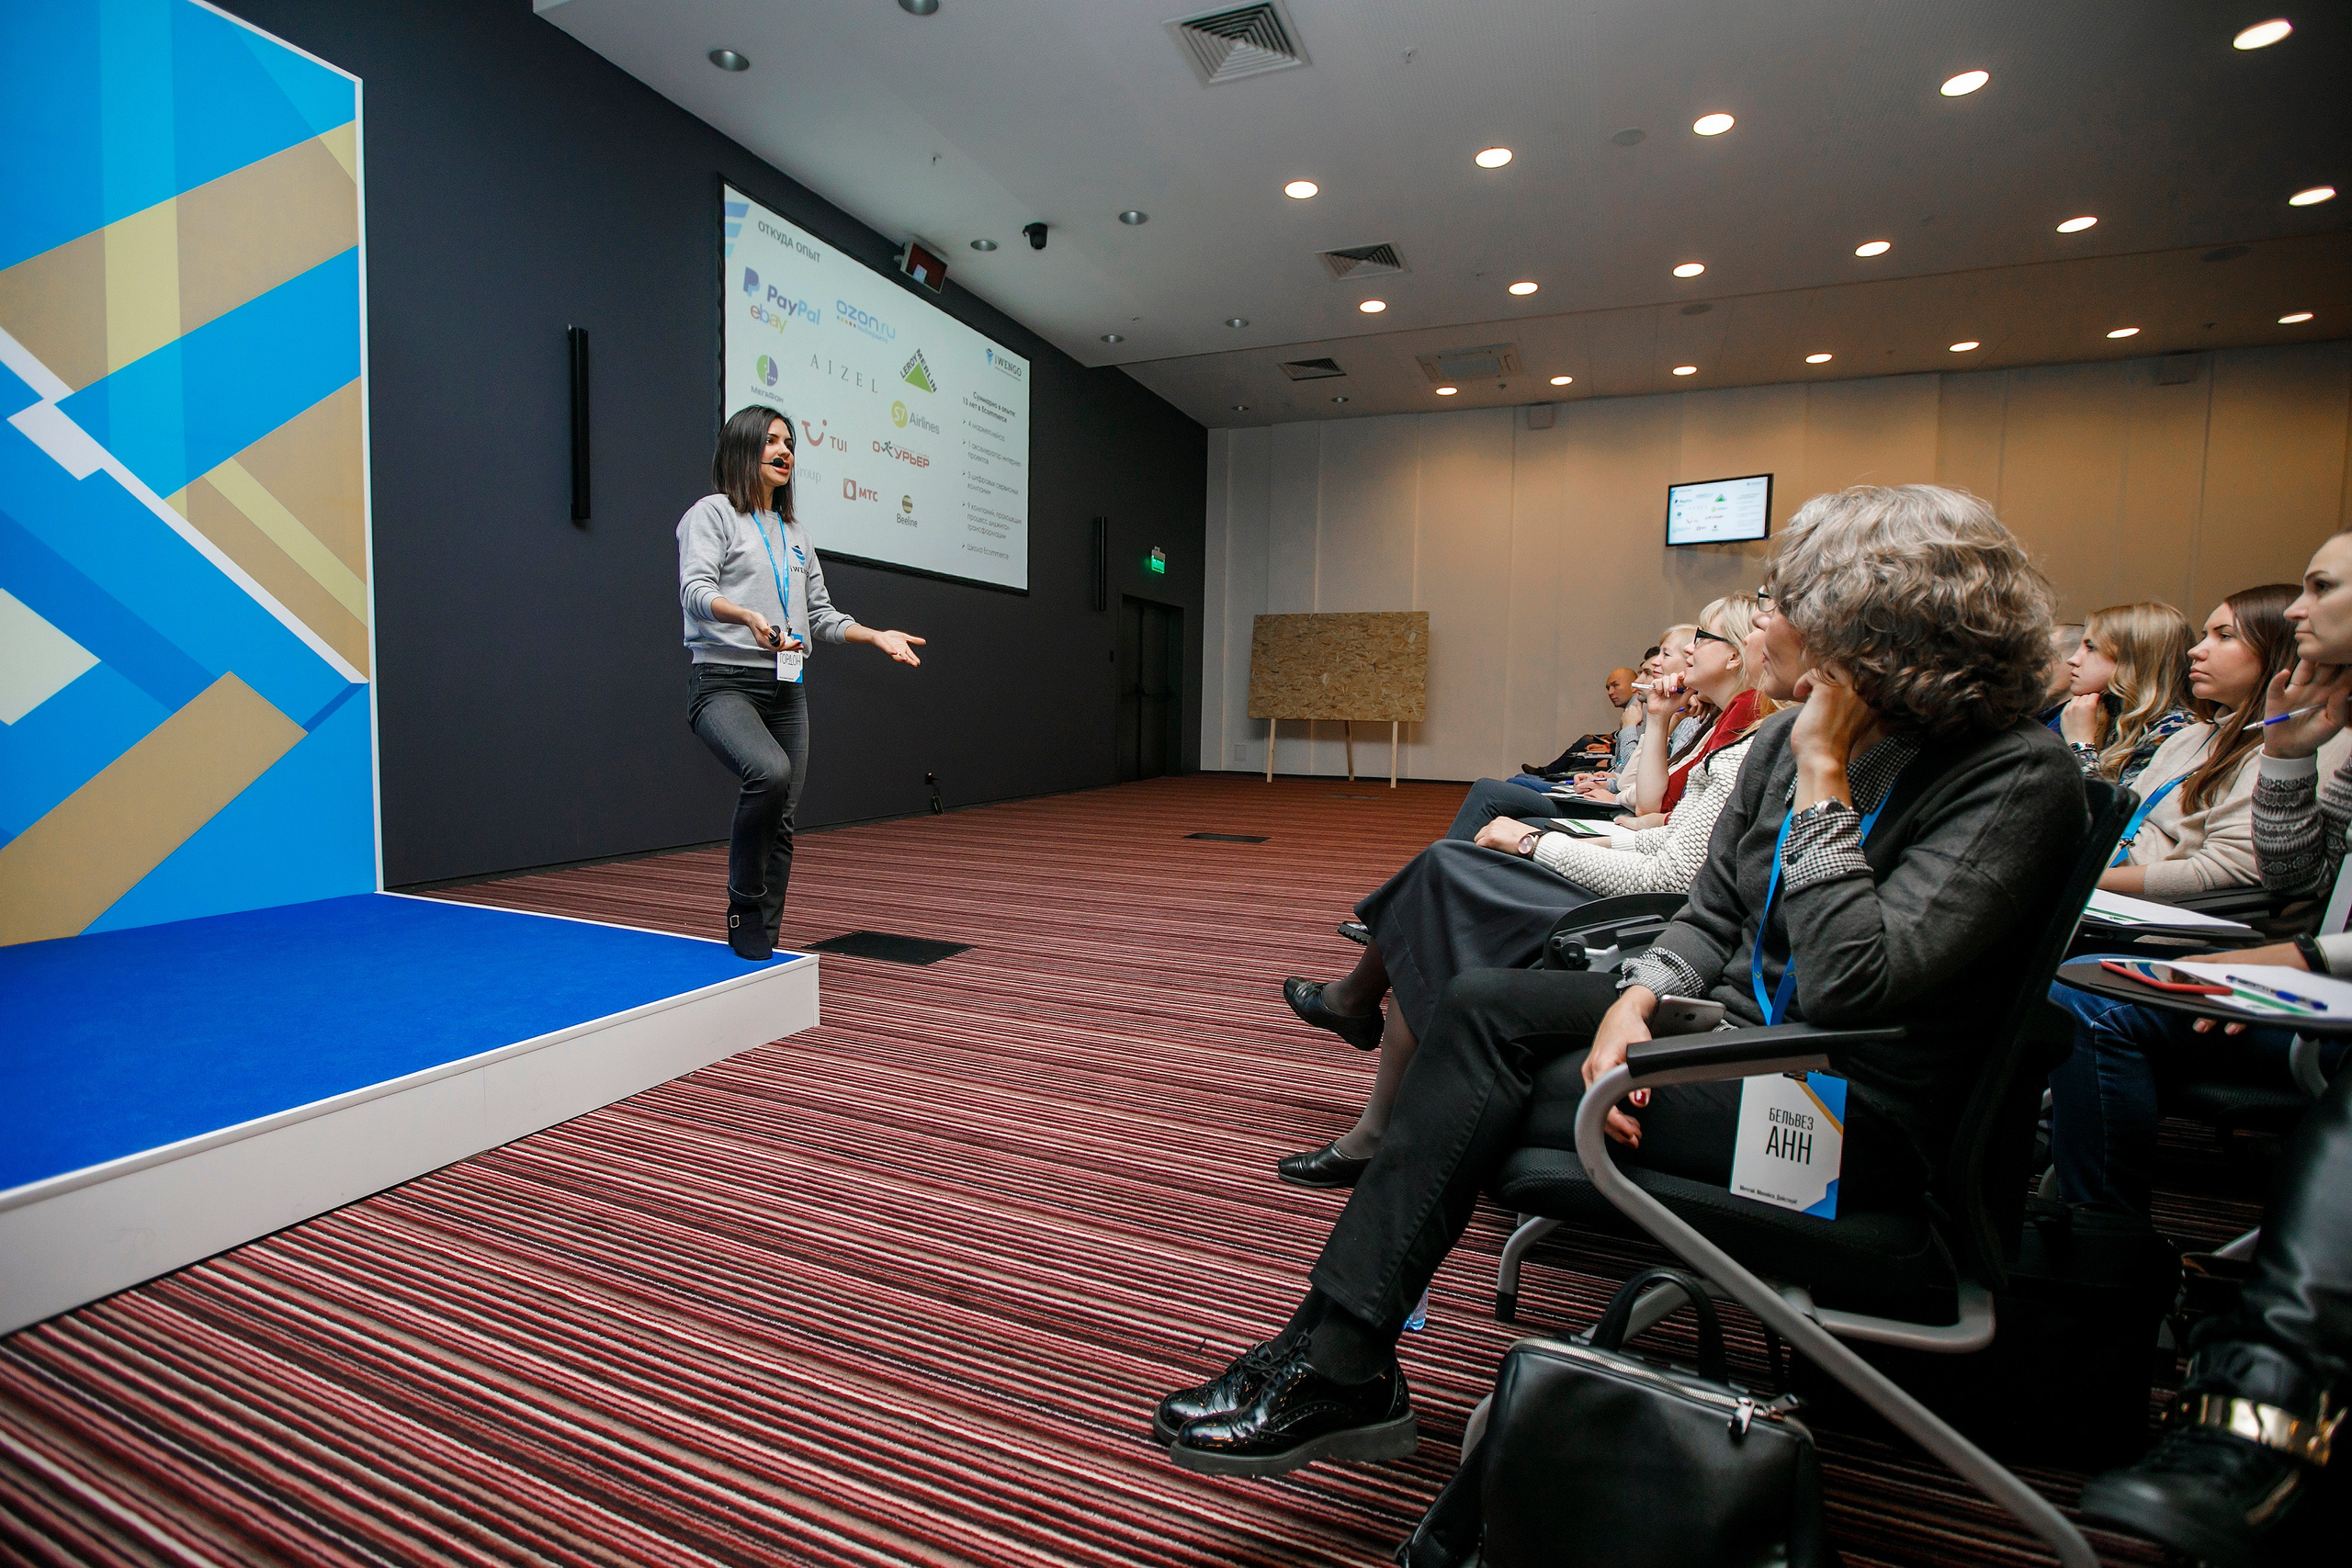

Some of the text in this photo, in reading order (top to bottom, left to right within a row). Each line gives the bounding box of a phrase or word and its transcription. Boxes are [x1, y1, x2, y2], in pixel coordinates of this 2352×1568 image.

[758, 220, 820, 263] ОТКУДА ОПЫТ
[750, 303, 786, 334] ebay
[766, 284, 820, 325] PayPal
[810, 354, 878, 394] AIZEL
[899, 353, 918, 378] LEROY
[916, 348, 937, 392] MERLIN
[893, 406, 940, 434] S7 Airlines
[830, 435, 847, 453] TUI
[859, 487, 878, 502] МТС
[897, 513, 918, 528] Beeline
[1769, 1107, 1815, 1131] БЕЛЬВЕЗ
[1766, 1125, 1813, 1165] АНН
